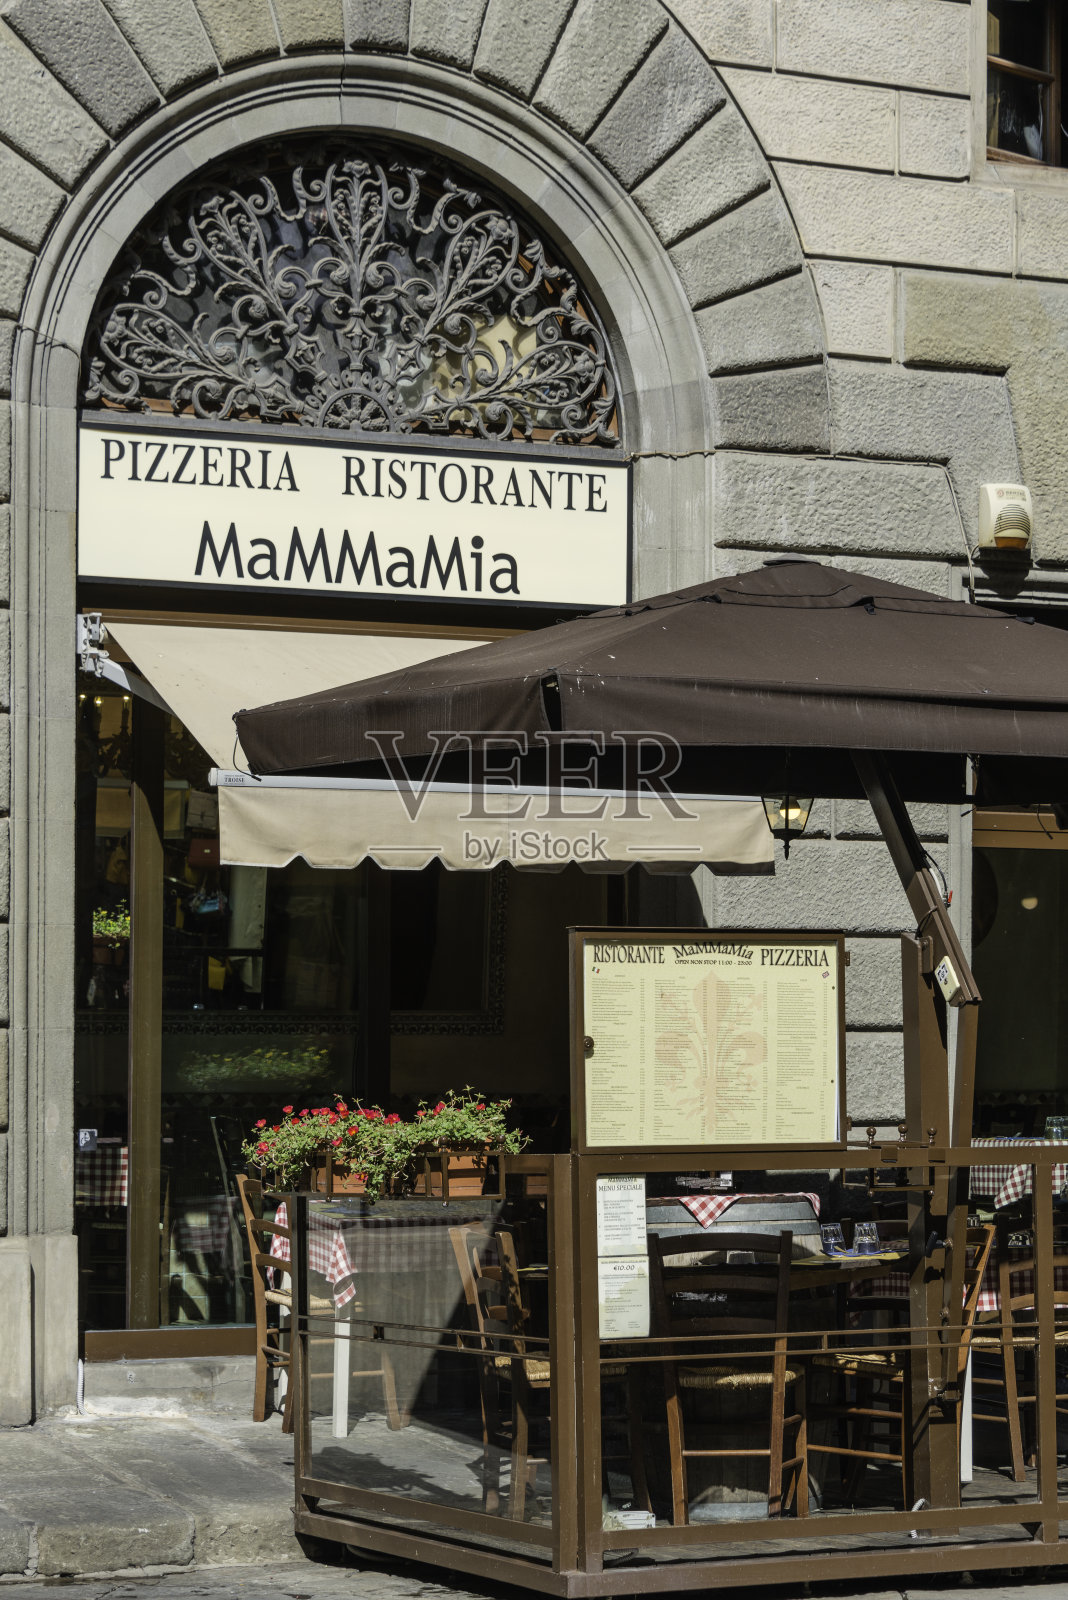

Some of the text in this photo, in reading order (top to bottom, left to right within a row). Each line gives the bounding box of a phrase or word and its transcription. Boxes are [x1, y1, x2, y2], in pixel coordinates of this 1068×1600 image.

[100, 438, 609, 513] PIZZERIA RISTORANTE
[194, 520, 521, 595] MaMMaMia
[593, 941, 829, 967] RISTORANTE MaMMaMia PIZZERIA
